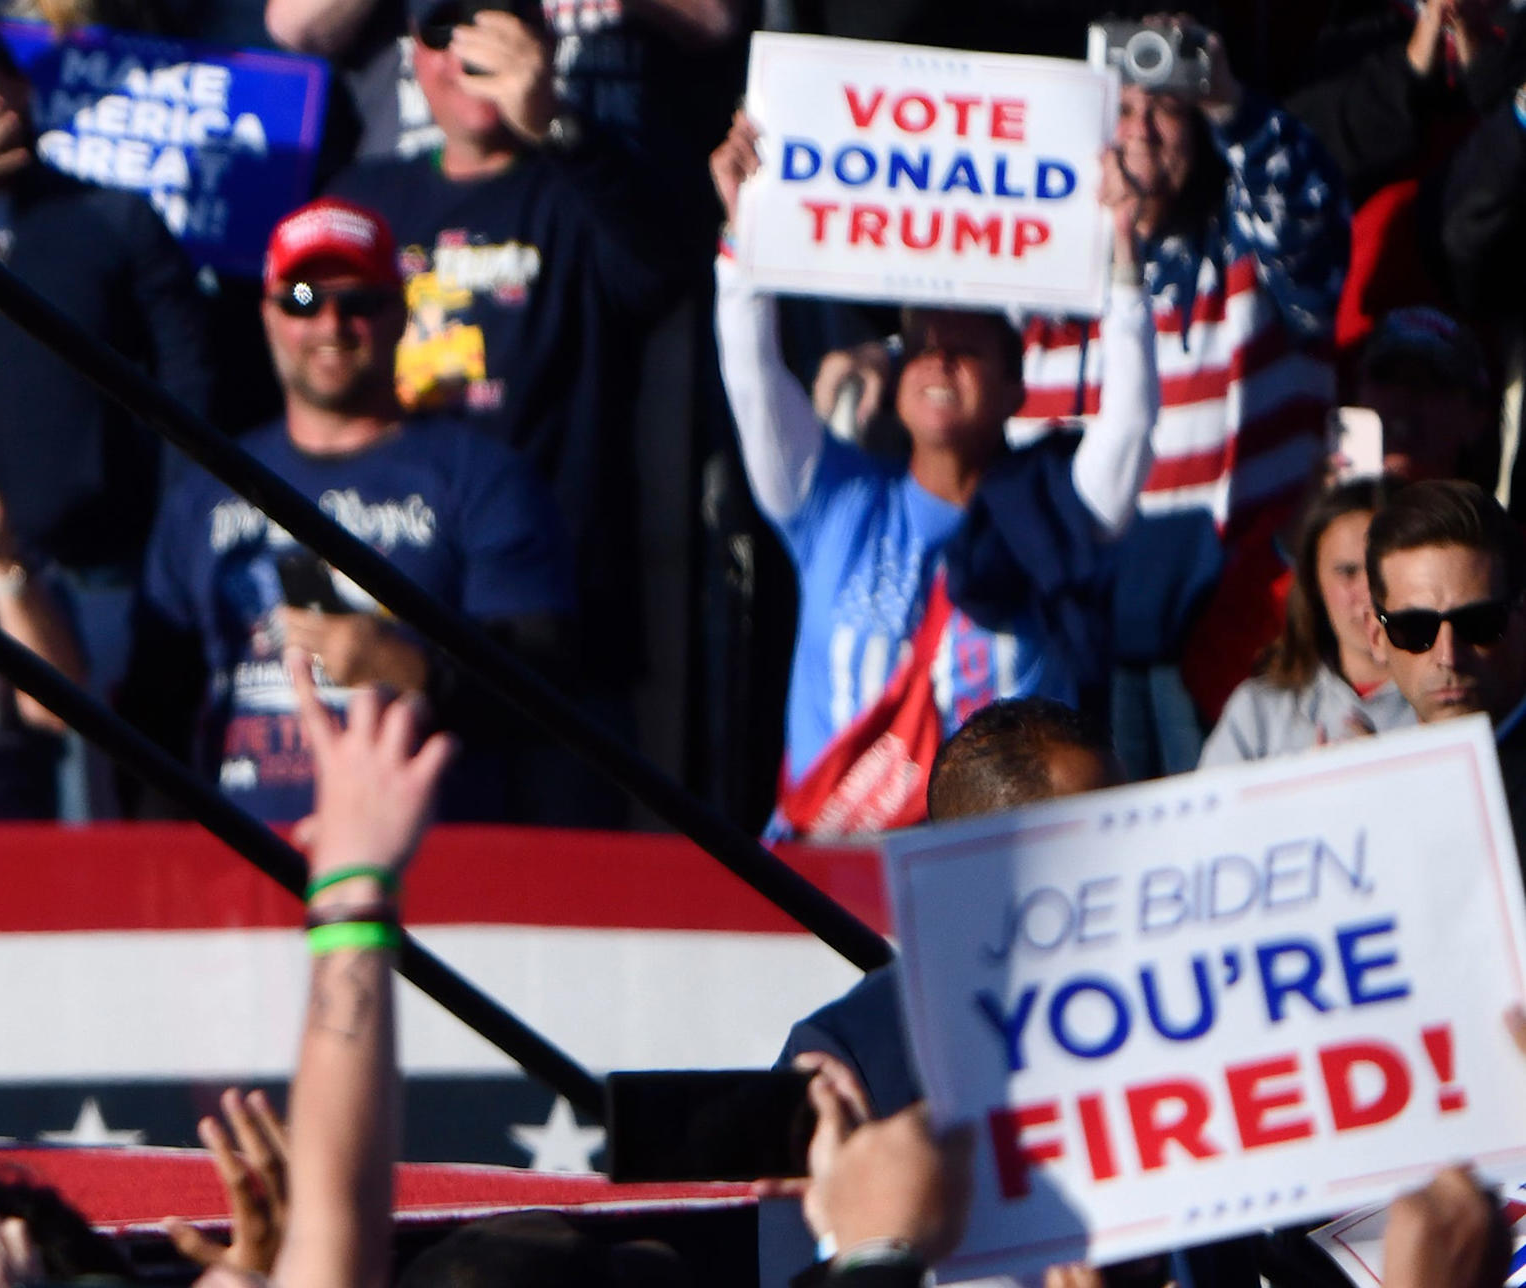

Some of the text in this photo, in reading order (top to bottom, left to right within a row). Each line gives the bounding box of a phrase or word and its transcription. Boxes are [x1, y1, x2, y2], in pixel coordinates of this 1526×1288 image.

[842, 84, 1028, 143] VOTE
[780, 136, 1078, 200] DONALD
[802, 197, 1052, 259] TRUMP
[981, 826, 1376, 966] JOE BIDEN,
[975, 915, 1414, 1073] YOU'RE
[987, 1021, 1469, 1202] FIRED!
